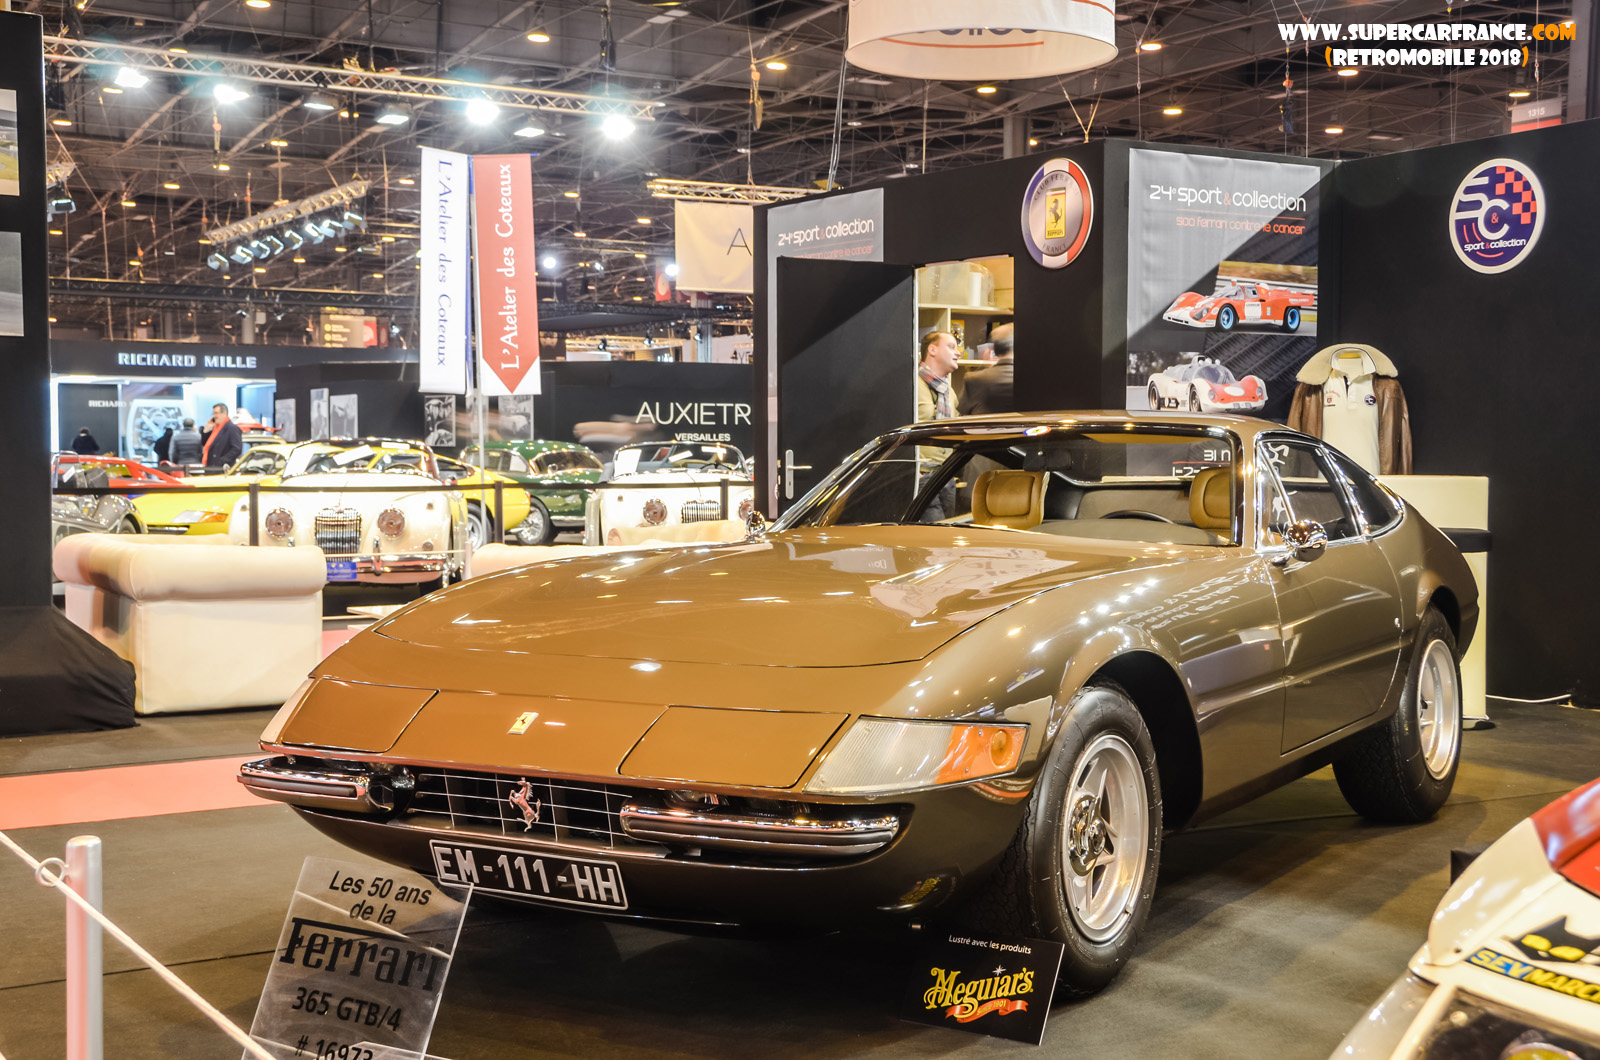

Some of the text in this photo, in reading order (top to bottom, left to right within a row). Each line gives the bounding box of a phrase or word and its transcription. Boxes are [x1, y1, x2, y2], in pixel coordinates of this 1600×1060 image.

[1528, 107, 1545, 117] 1315
[1177, 186, 1222, 207] sport
[1223, 192, 1232, 206] &
[1232, 190, 1306, 212] collection
[793, 225, 820, 247] sport
[825, 218, 875, 239] collection
[1176, 216, 1305, 235] 500 ferrari contre le cancer
[727, 228, 752, 256] A
[1464, 242, 1485, 252] sport
[1489, 238, 1526, 249] collection
[437, 159, 453, 366] L'Atelier des Coteaux
[495, 164, 520, 370] L'Atelier des Coteaux
[118, 352, 257, 369] RICHARD MILLE
[675, 433, 731, 442] VERSAILLES
[329, 870, 432, 906] Les 50 ans
[350, 900, 397, 925] de la
[279, 917, 445, 991] Ferrari
[948, 935, 1032, 955] Lustré avec les produits
[1470, 949, 1535, 978] SEV
[923, 967, 1034, 1018] Meguiar's
[292, 987, 402, 1032] 365 GTB/4
[295, 1034, 309, 1057] #
